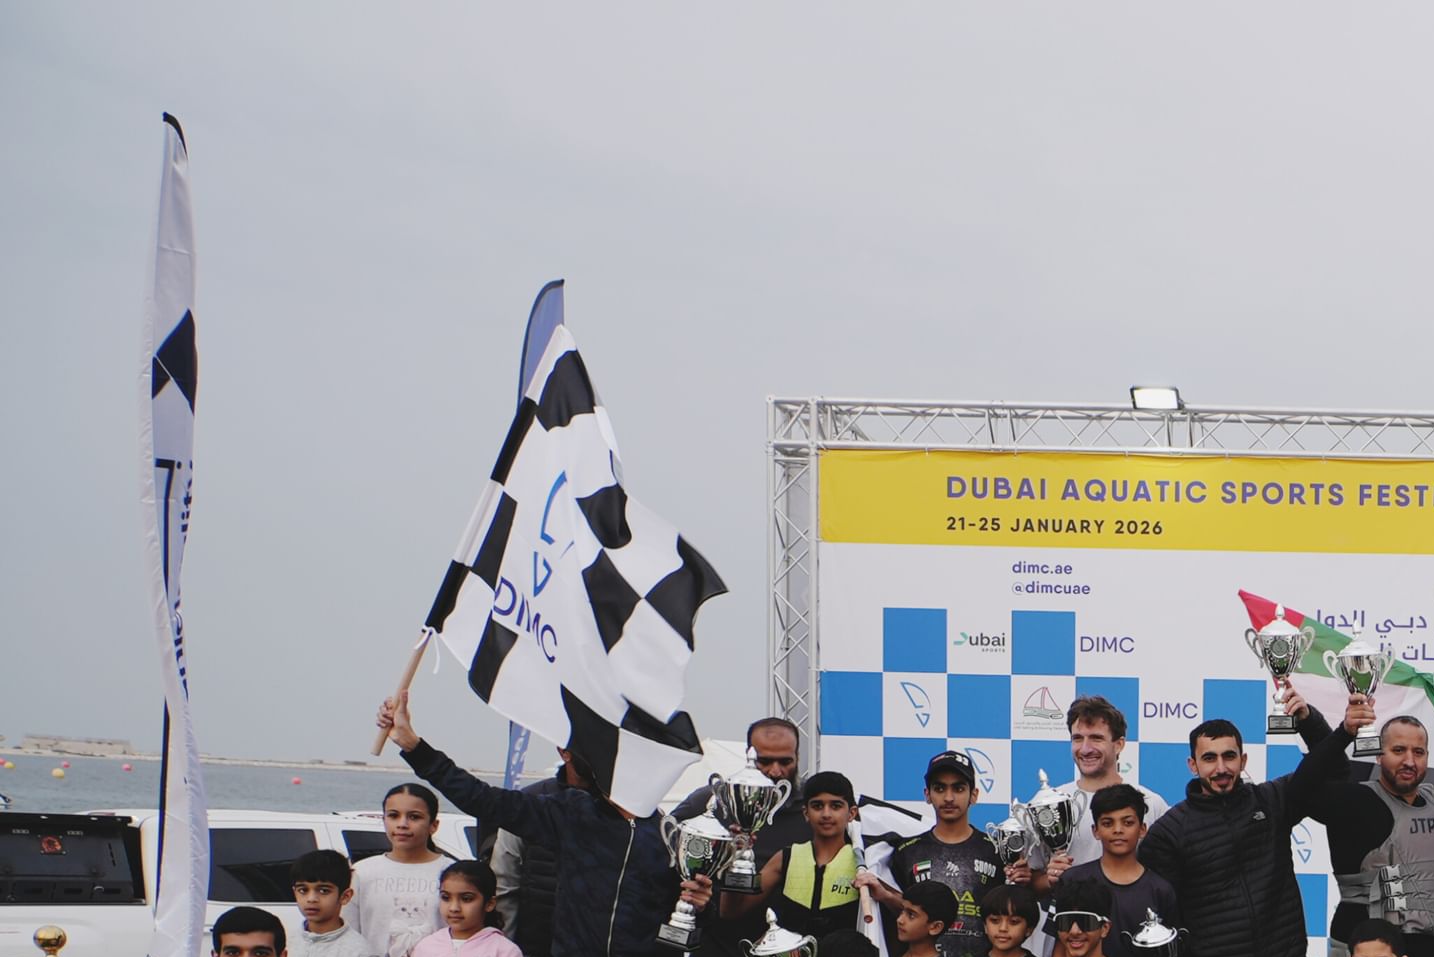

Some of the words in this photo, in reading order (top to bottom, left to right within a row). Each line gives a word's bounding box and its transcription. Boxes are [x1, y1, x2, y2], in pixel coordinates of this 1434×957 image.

[946, 476, 1046, 500] DUBAI
[1061, 478, 1207, 504] AQUATIC
[1221, 481, 1344, 506] SPORTS
[946, 516, 1001, 532] 21-25
[1010, 518, 1105, 534] JANUARY
[1114, 520, 1163, 535] 2026
[1012, 561, 1073, 575] dimc.ae
[1012, 581, 1091, 595] @dimcuae
[493, 576, 558, 663] DIMC
[1375, 614, 1428, 639] دبي
[1080, 636, 1135, 653] DIMC
[1144, 702, 1198, 719] DIMC
[374, 877, 439, 894] FREEDO
